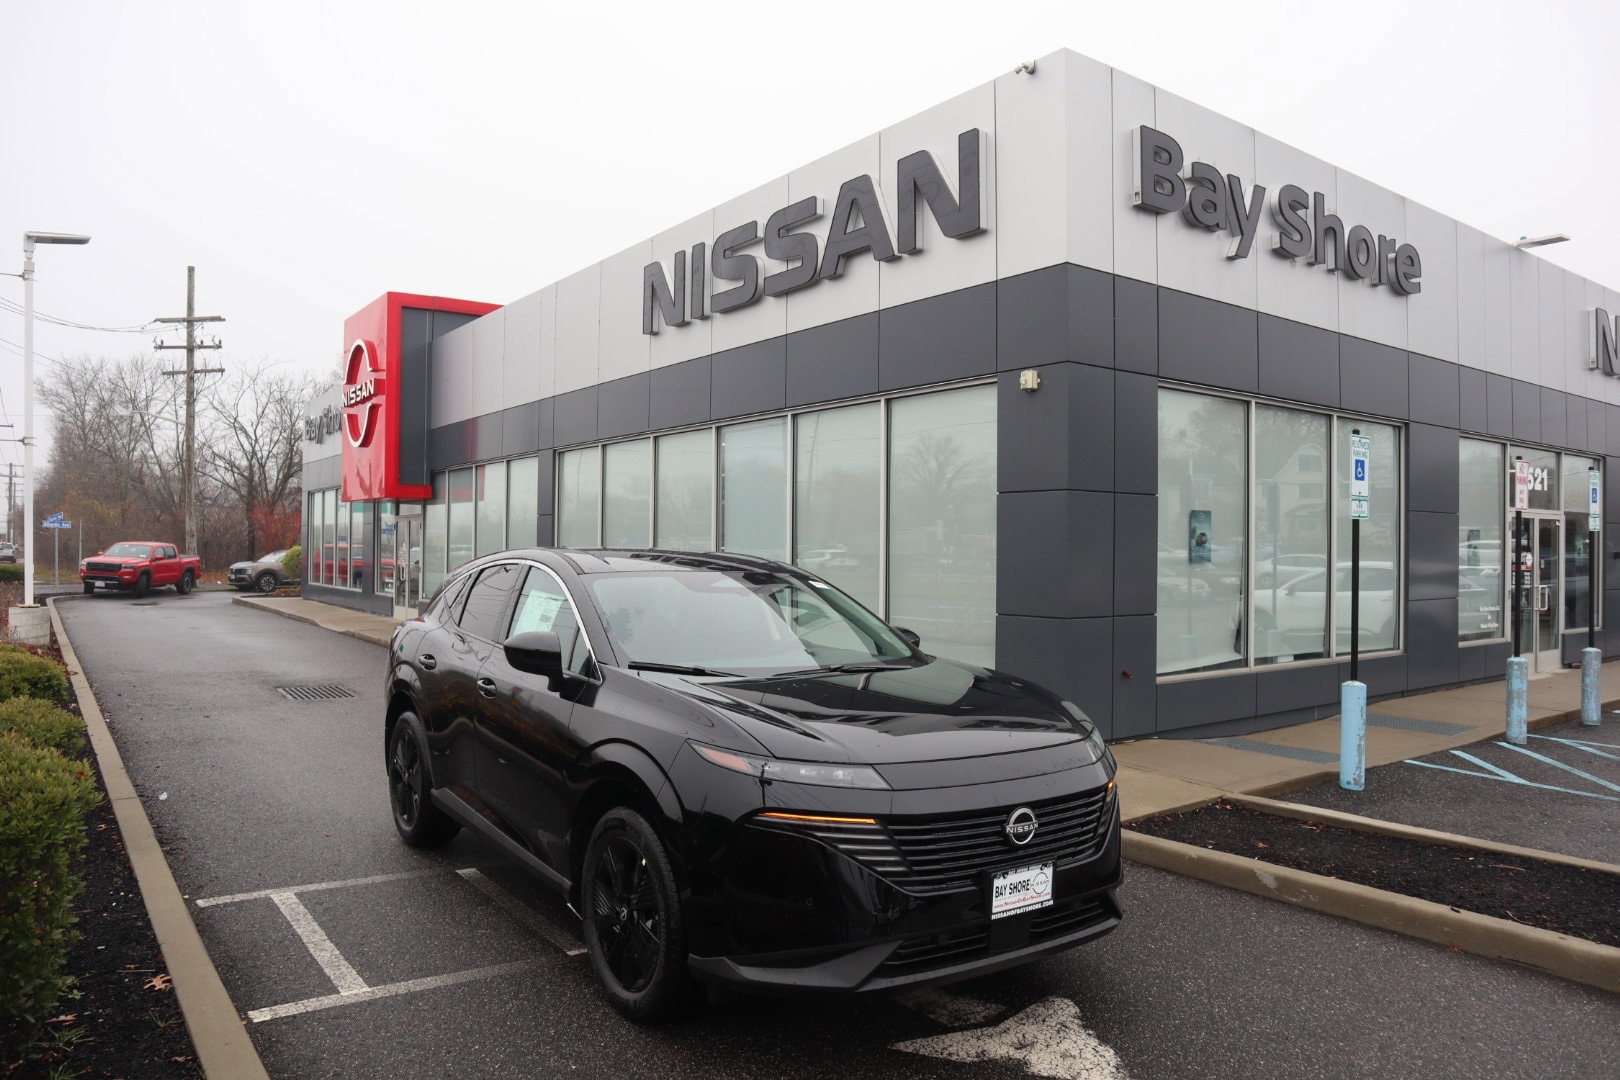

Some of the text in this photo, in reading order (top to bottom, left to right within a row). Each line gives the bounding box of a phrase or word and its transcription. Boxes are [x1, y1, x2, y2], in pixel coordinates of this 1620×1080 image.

[1132, 125, 1423, 296] Bay Shore
[643, 127, 988, 336] NISSAN
[341, 377, 375, 407] NISSAN
[304, 415, 325, 445] Bay
[1006, 822, 1038, 834] NISSAN
[994, 884, 1008, 898] BAY
[1009, 879, 1030, 895] SHORE
